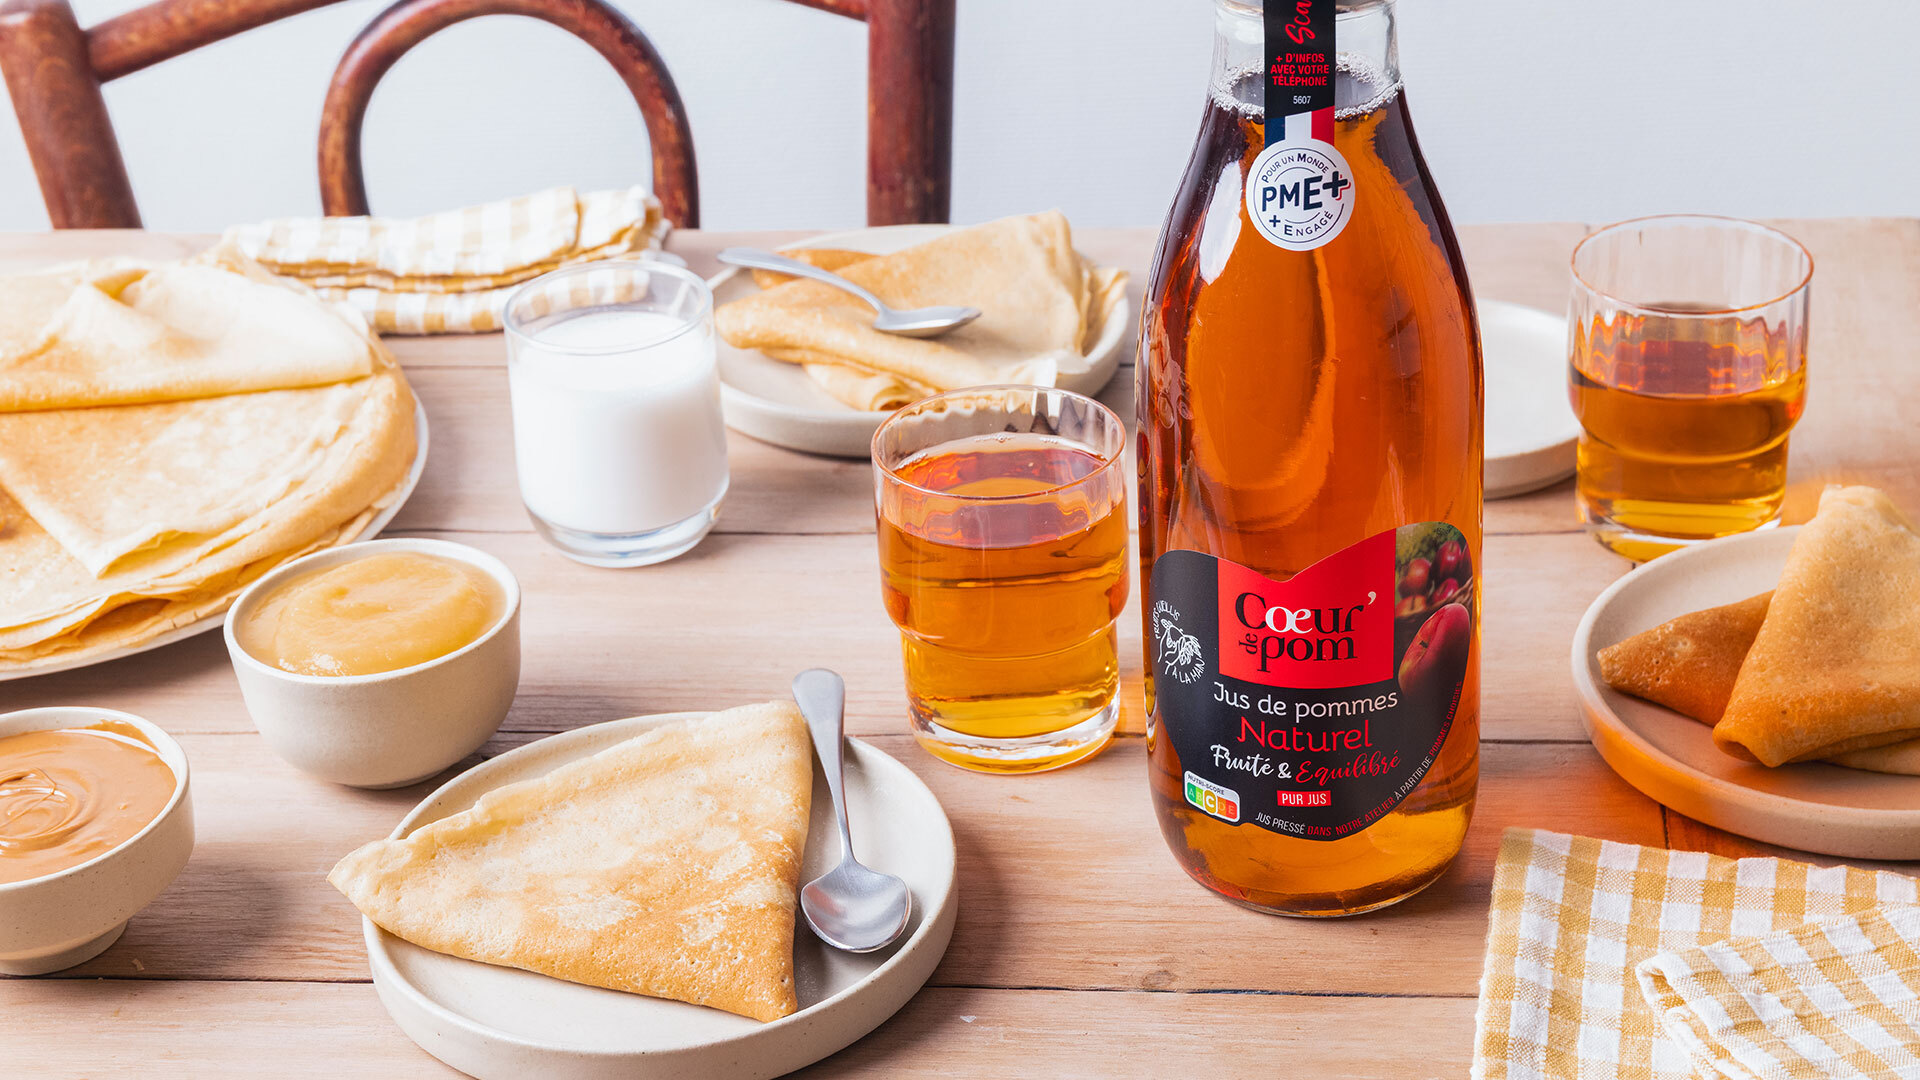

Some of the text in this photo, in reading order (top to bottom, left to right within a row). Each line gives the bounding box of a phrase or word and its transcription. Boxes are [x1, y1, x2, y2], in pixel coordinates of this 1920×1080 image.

[1285, 0, 1316, 44] Sca
[1270, 64, 1330, 74] AVEC VOTRE
[1285, 53, 1325, 63] D'INFOS
[1272, 74, 1328, 86] TÉLÉPHONE
[1292, 95, 1312, 105] 5607
[1281, 155, 1295, 165] UN
[1296, 153, 1330, 174] MONDE
[1284, 210, 1334, 237] ENGAGÉ
[1238, 633, 1258, 655] de
[1256, 635, 1356, 673] pom
[1179, 671, 1191, 684] LA
[1213, 681, 1398, 723] Jus de pommes
[1236, 715, 1373, 752] Naturel
[1210, 743, 1401, 786] Fruité & Equilibré
[1187, 774, 1225, 796] NUTRI-SCORE
[1254, 812, 1272, 825] JUS
[1271, 817, 1306, 835] PRESSÉ
[1307, 825, 1332, 837] DANS
[1335, 817, 1364, 836] NOTRE
[1364, 796, 1396, 823] ATELIER
[1400, 767, 1425, 795] PARTIR
[1421, 755, 1433, 769] DE
[1428, 721, 1451, 757] POMMES
[1205, 796, 1215, 808] C
[1281, 793, 1327, 805] PUR JUS
